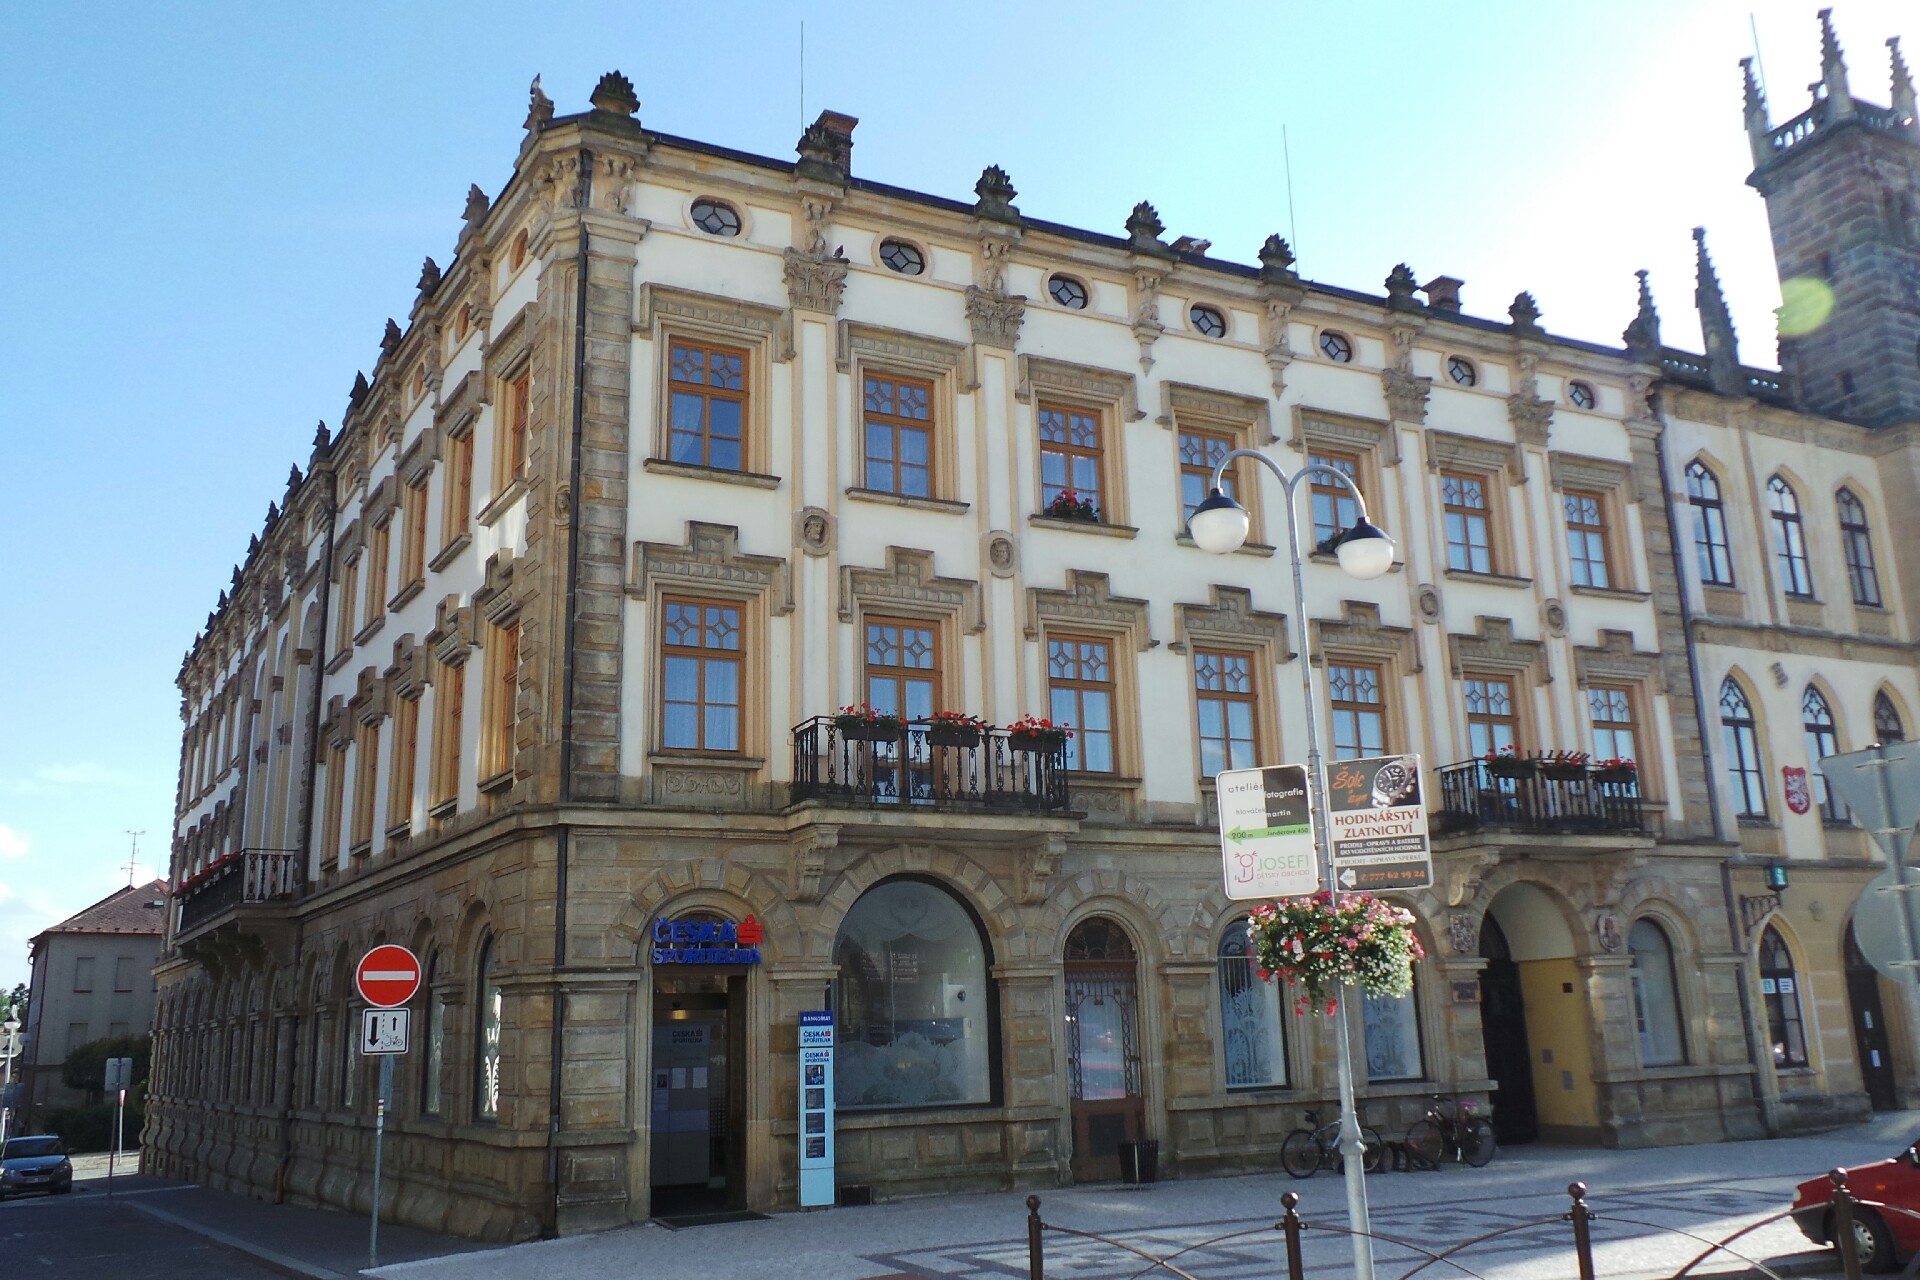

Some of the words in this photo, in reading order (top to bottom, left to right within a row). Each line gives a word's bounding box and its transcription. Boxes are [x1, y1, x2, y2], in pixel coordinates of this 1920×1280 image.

[1227, 782, 1263, 793] ateliér
[1263, 787, 1304, 799] fotografie
[1266, 809, 1291, 818] martin
[1335, 808, 1419, 826] HODINÁŘSTVÍ
[1344, 821, 1413, 838] ZLATNICTVÍ
[1231, 831, 1247, 840] 200
[1366, 839, 1390, 847] OPRAVY
[1257, 854, 1309, 871] JOSEFI
[653, 917, 736, 943] ČESKÁ
[653, 944, 762, 964] SPOŘITELNA
[803, 1029, 825, 1038] ČESKÁ
[805, 1051, 824, 1059] ČESKÁ
